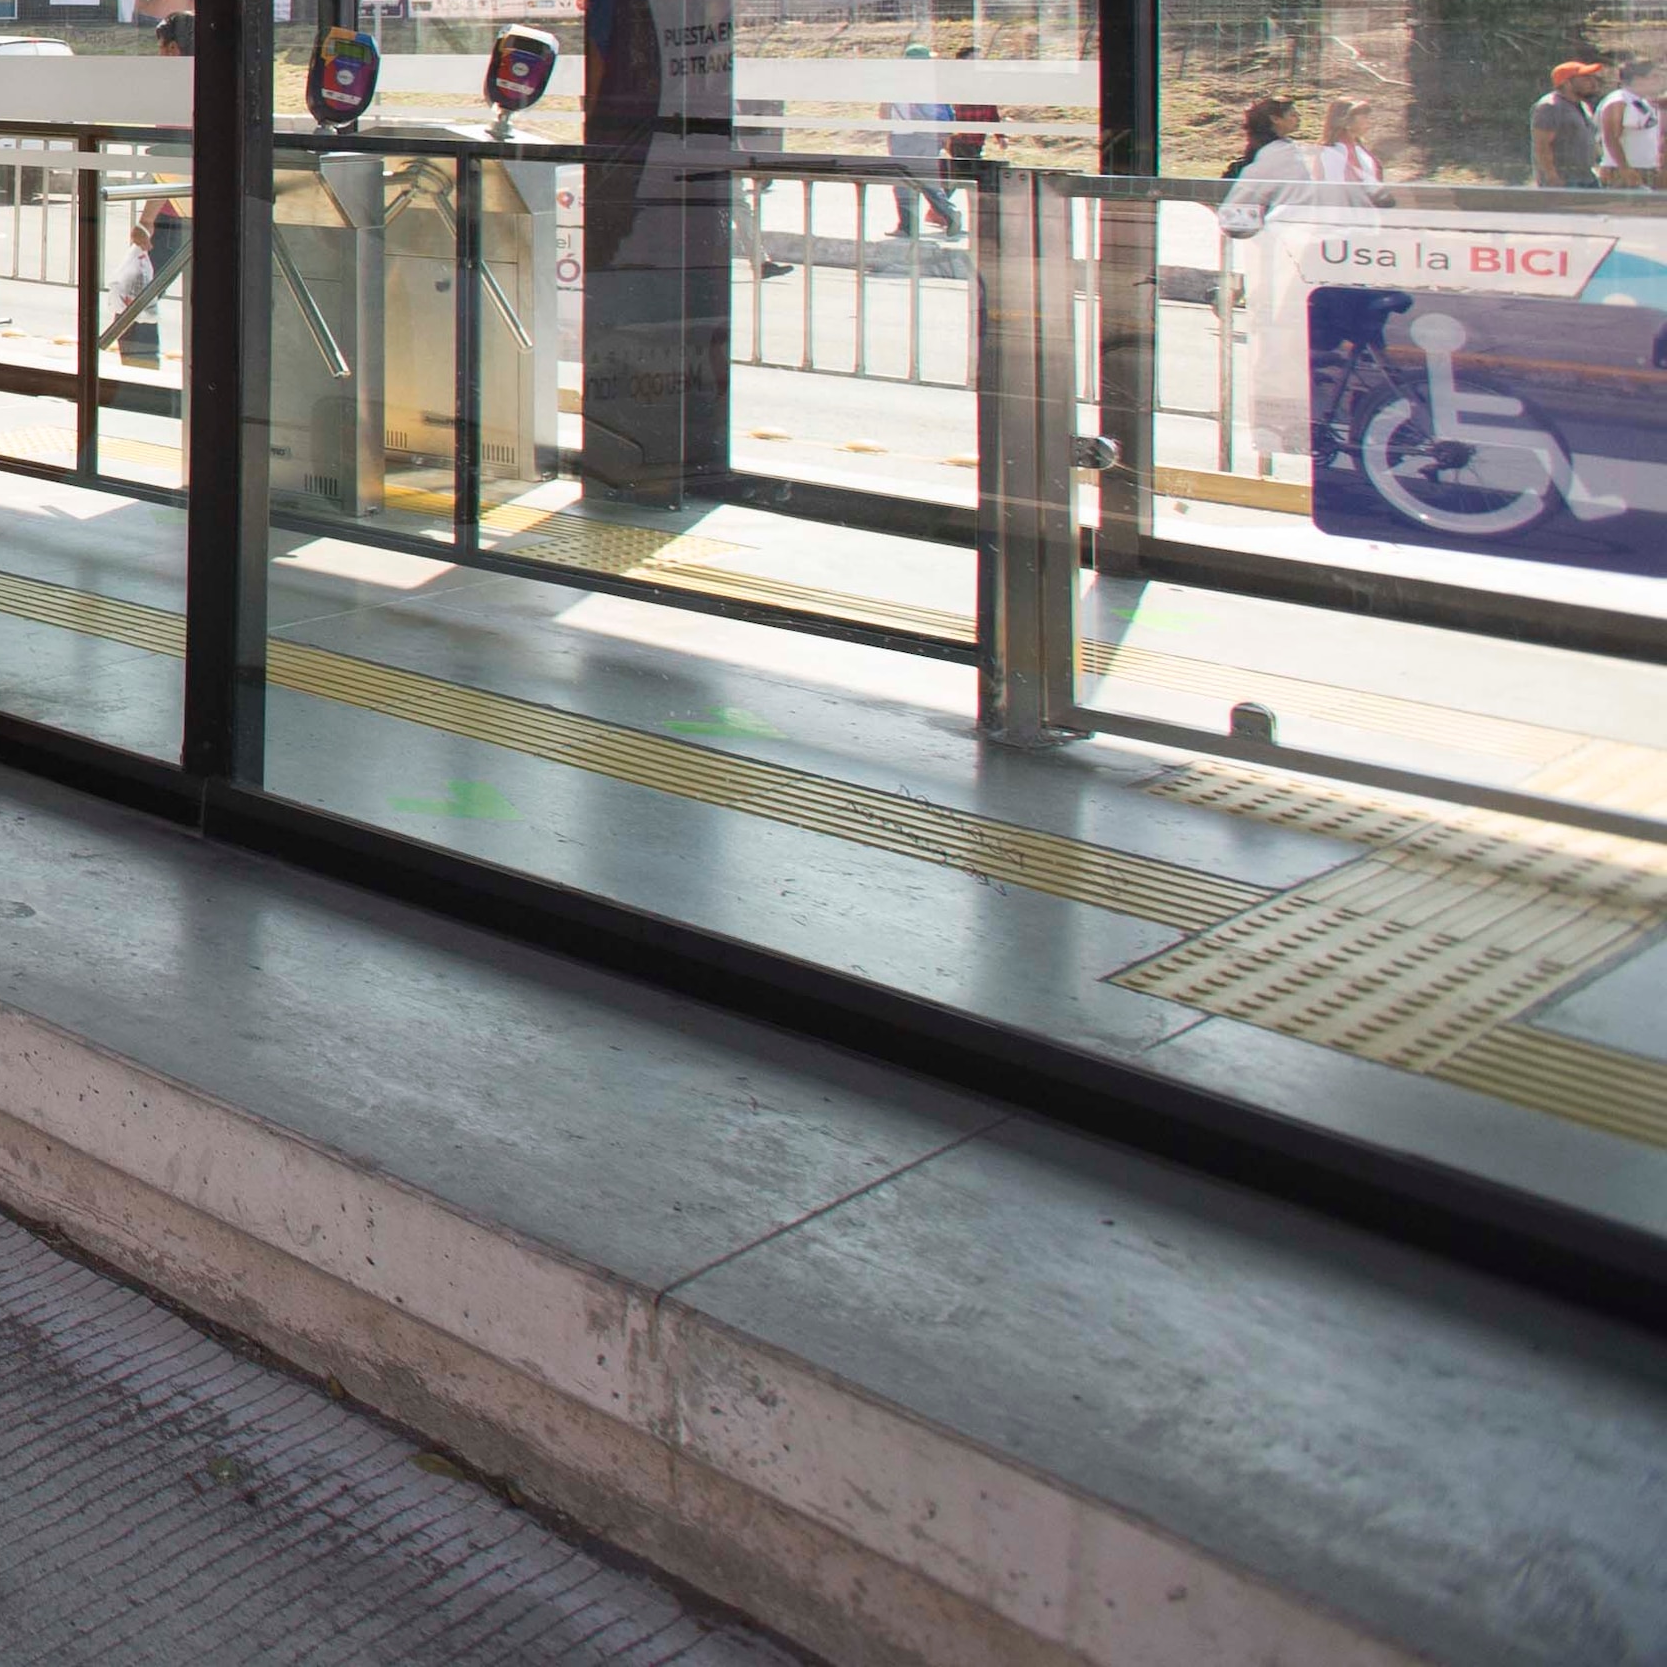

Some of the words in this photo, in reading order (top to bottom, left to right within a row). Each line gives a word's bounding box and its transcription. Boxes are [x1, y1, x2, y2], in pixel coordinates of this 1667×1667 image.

[1320, 239, 1397, 270] Usa
[1415, 242, 1450, 271] la
[1469, 245, 1568, 278] BICI
